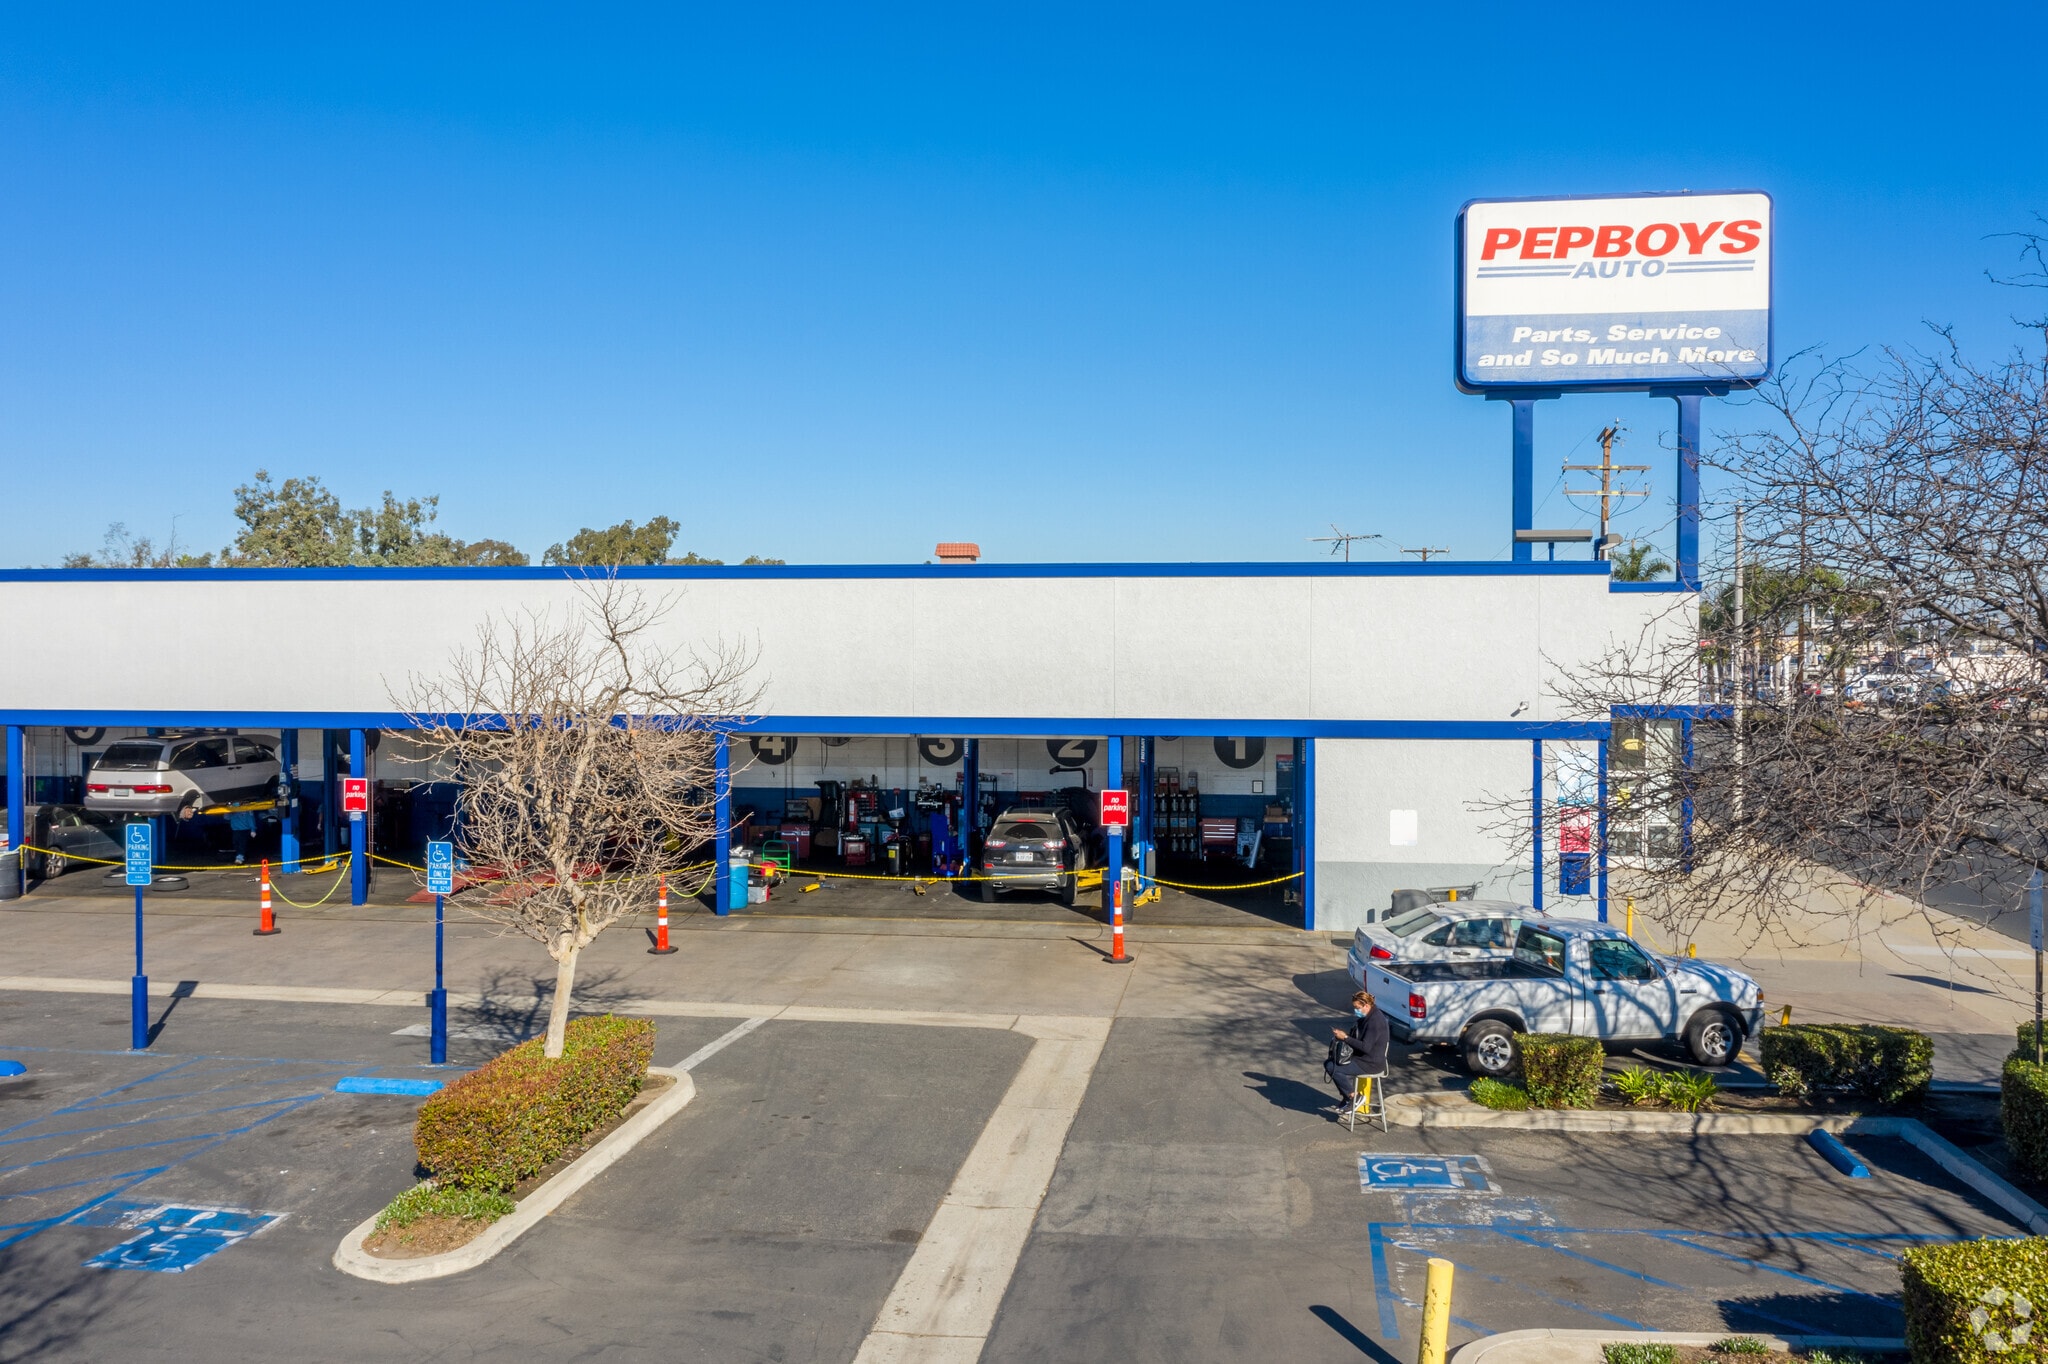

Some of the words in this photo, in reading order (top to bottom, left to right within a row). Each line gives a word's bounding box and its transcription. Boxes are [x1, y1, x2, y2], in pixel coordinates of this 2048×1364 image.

[1480, 219, 1762, 261] PEPBOYS
[1572, 259, 1665, 279] AUTO
[1512, 326, 1598, 344] Parts,
[1607, 323, 1721, 341] Service
[1478, 349, 1533, 367] and
[1541, 349, 1578, 366] So
[1587, 348, 1669, 365] Much
[1678, 347, 1756, 363] More
[346, 791, 366, 799] parking
[1103, 804, 1127, 812] parking
